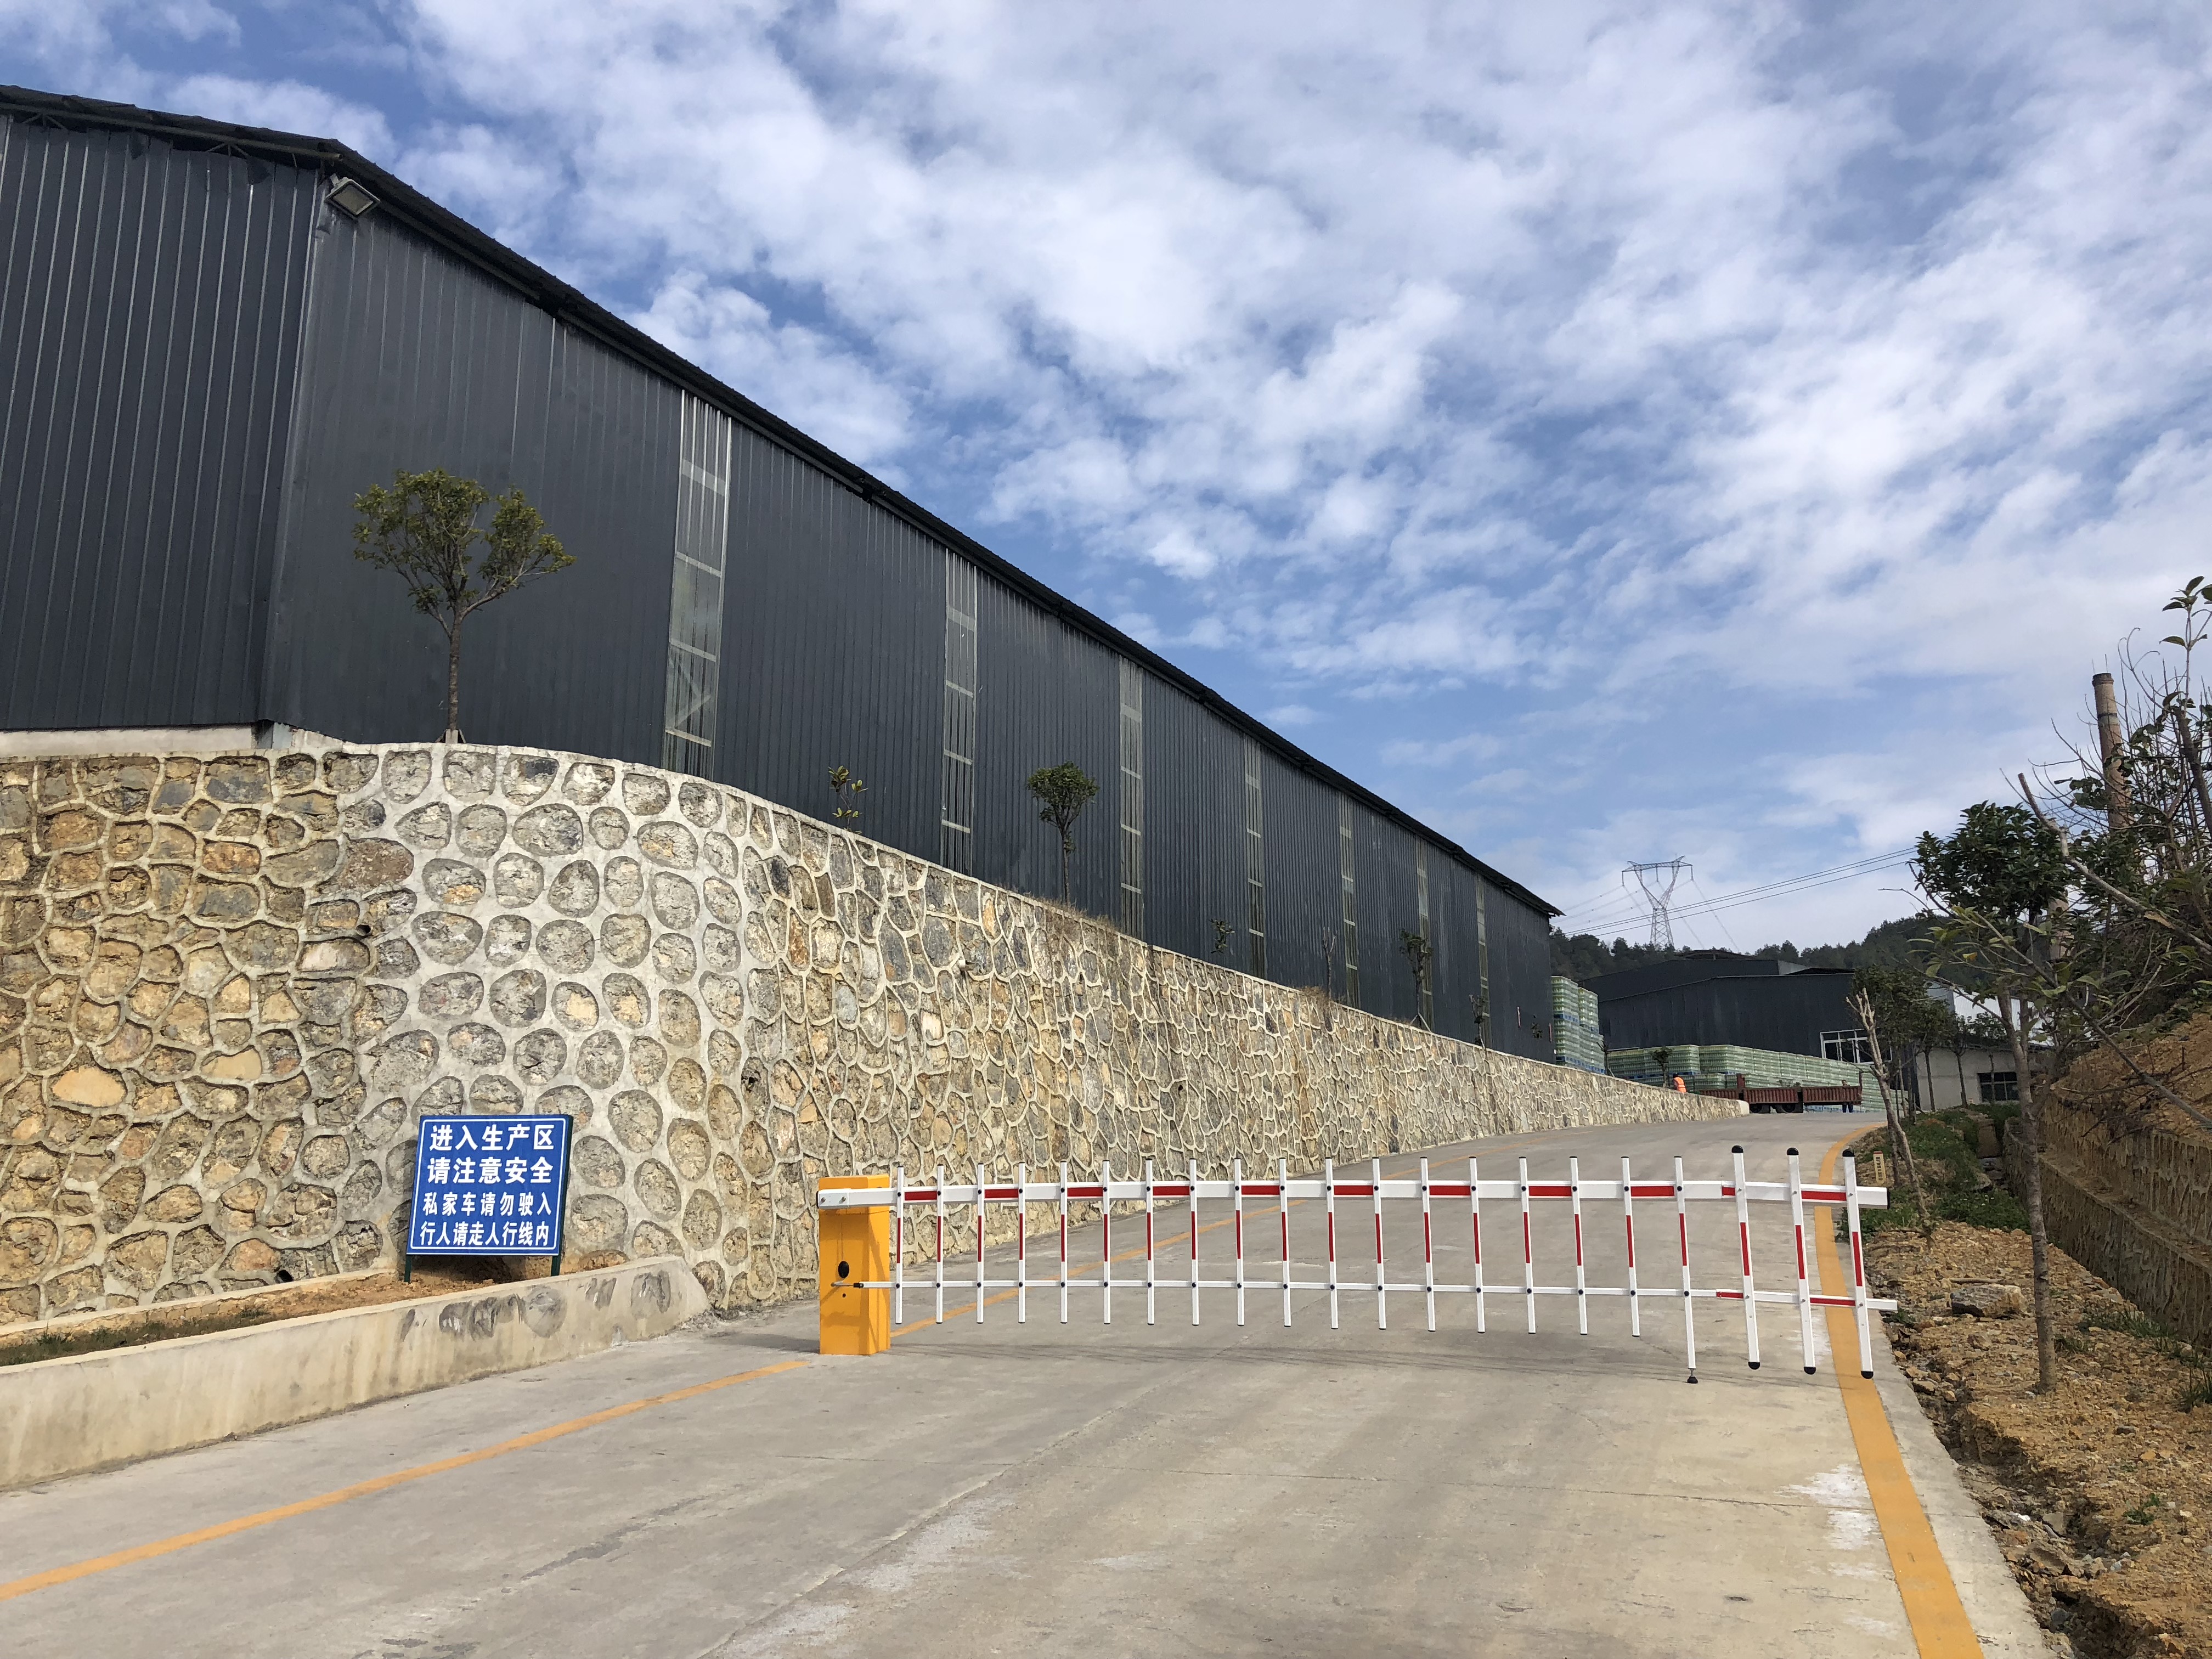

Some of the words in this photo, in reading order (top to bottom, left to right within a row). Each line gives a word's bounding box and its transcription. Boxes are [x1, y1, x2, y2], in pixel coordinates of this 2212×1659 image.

[430, 1124, 554, 1151] 进入生产区
[427, 1156, 553, 1184] 请注意安全
[422, 1192, 551, 1216] 私家车请勿驶入
[420, 1221, 549, 1246] 行人请走人行线内
